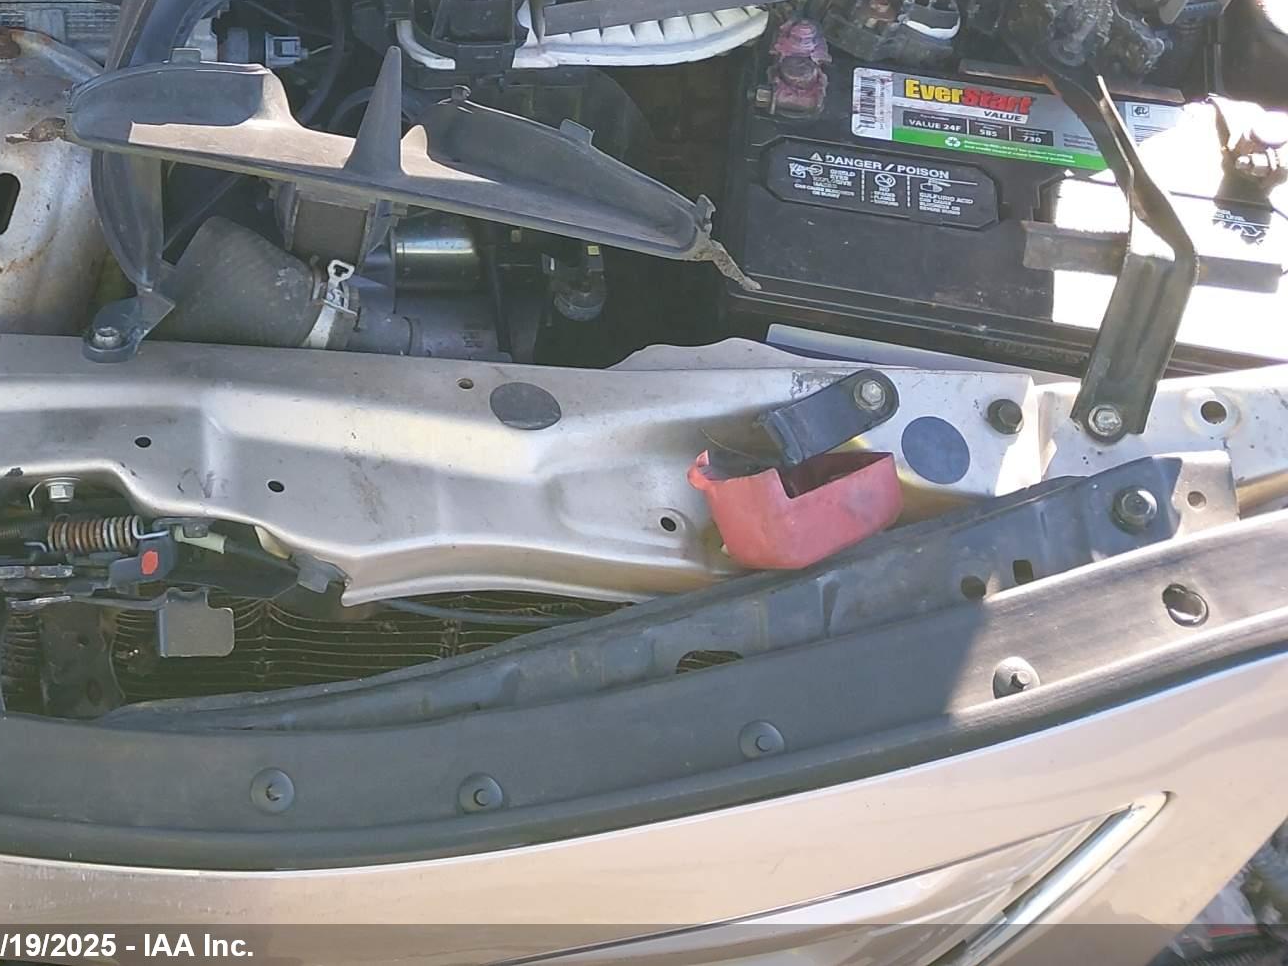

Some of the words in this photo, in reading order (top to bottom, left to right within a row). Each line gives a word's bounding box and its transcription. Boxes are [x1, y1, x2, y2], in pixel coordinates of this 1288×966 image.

[904, 78, 1033, 114] EverStart
[908, 118, 941, 130] VALUE
[943, 122, 962, 132] 24F
[983, 110, 1023, 122] VALUE
[825, 154, 882, 170] DANGER
[897, 164, 950, 179] POISON
